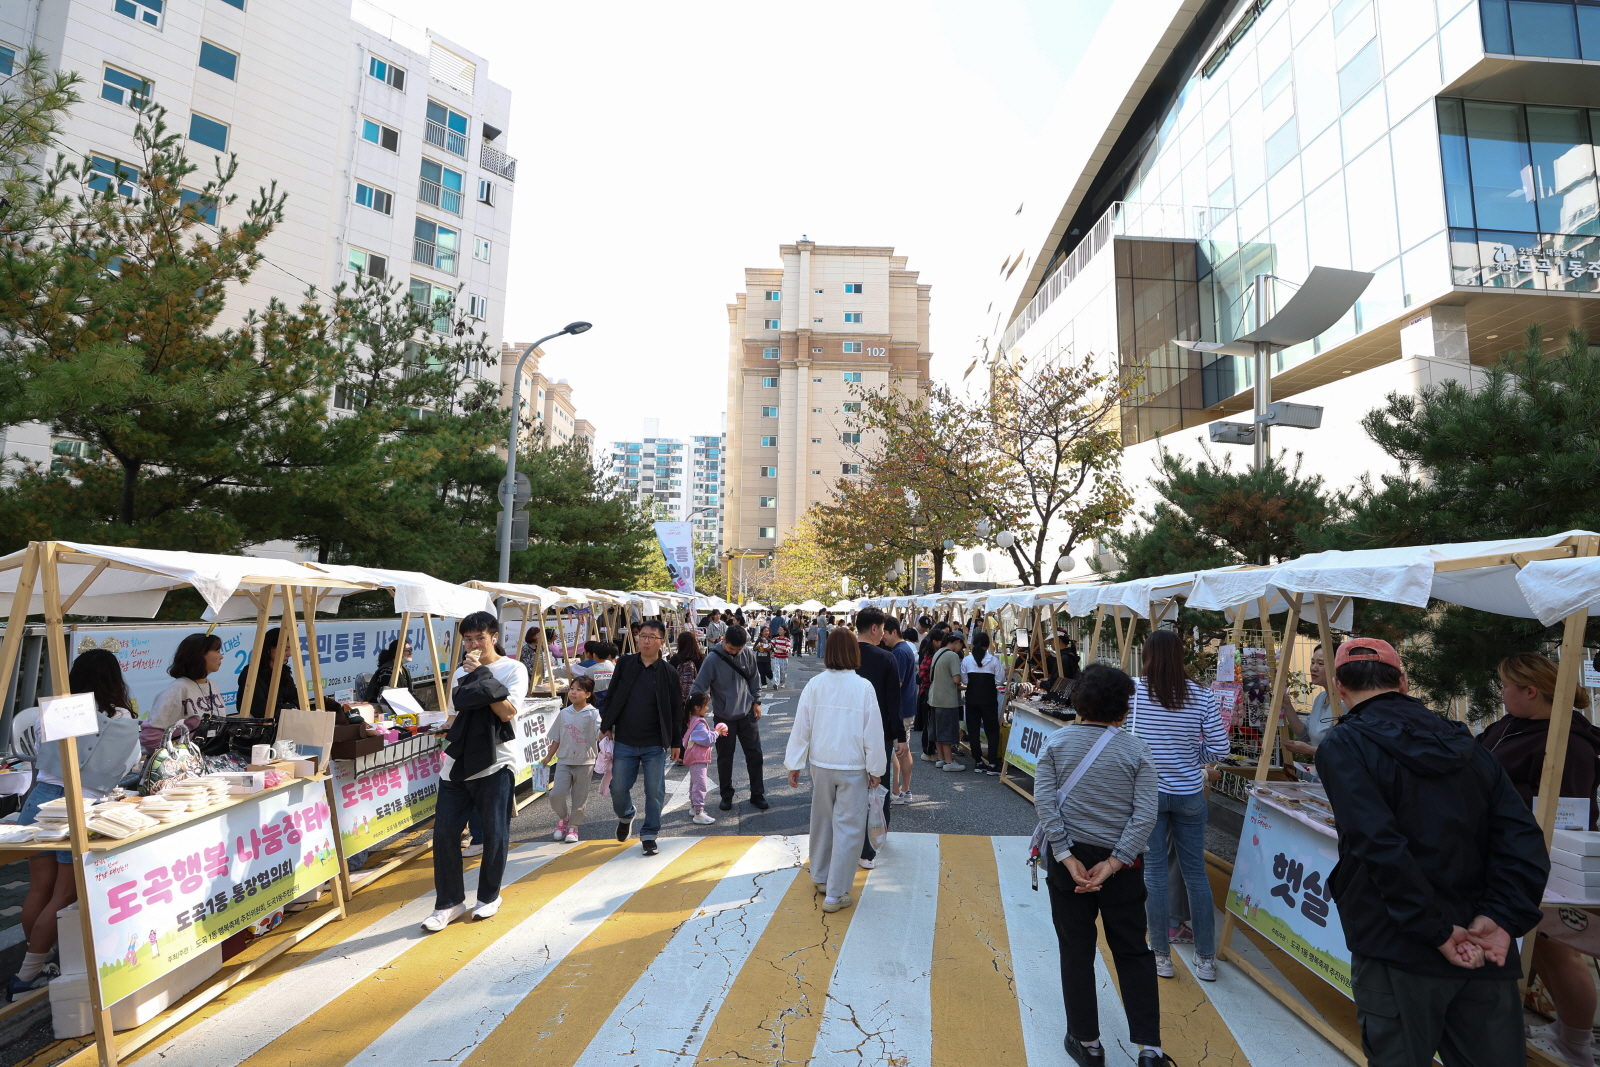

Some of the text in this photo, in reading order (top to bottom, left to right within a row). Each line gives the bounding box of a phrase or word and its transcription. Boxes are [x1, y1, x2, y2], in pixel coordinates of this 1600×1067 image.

[1518, 247, 1585, 259] 오늘도, 내일도 행복
[866, 347, 886, 357] 102
[523, 714, 546, 738] 아누달
[1020, 726, 1047, 759] 티마
[341, 765, 402, 809] 도곡행복
[375, 783, 438, 820] 도곡1동 통장협의회
[107, 802, 323, 925] 도곡행복 나눔장터
[176, 858, 293, 933] 도곡1동 통장협의회
[195, 935, 208, 949] 도곡
[208, 928, 218, 941] 1동
[217, 917, 241, 936] 행복축제
[1290, 939, 1301, 953] 도곡
[1300, 947, 1309, 959] 1동
